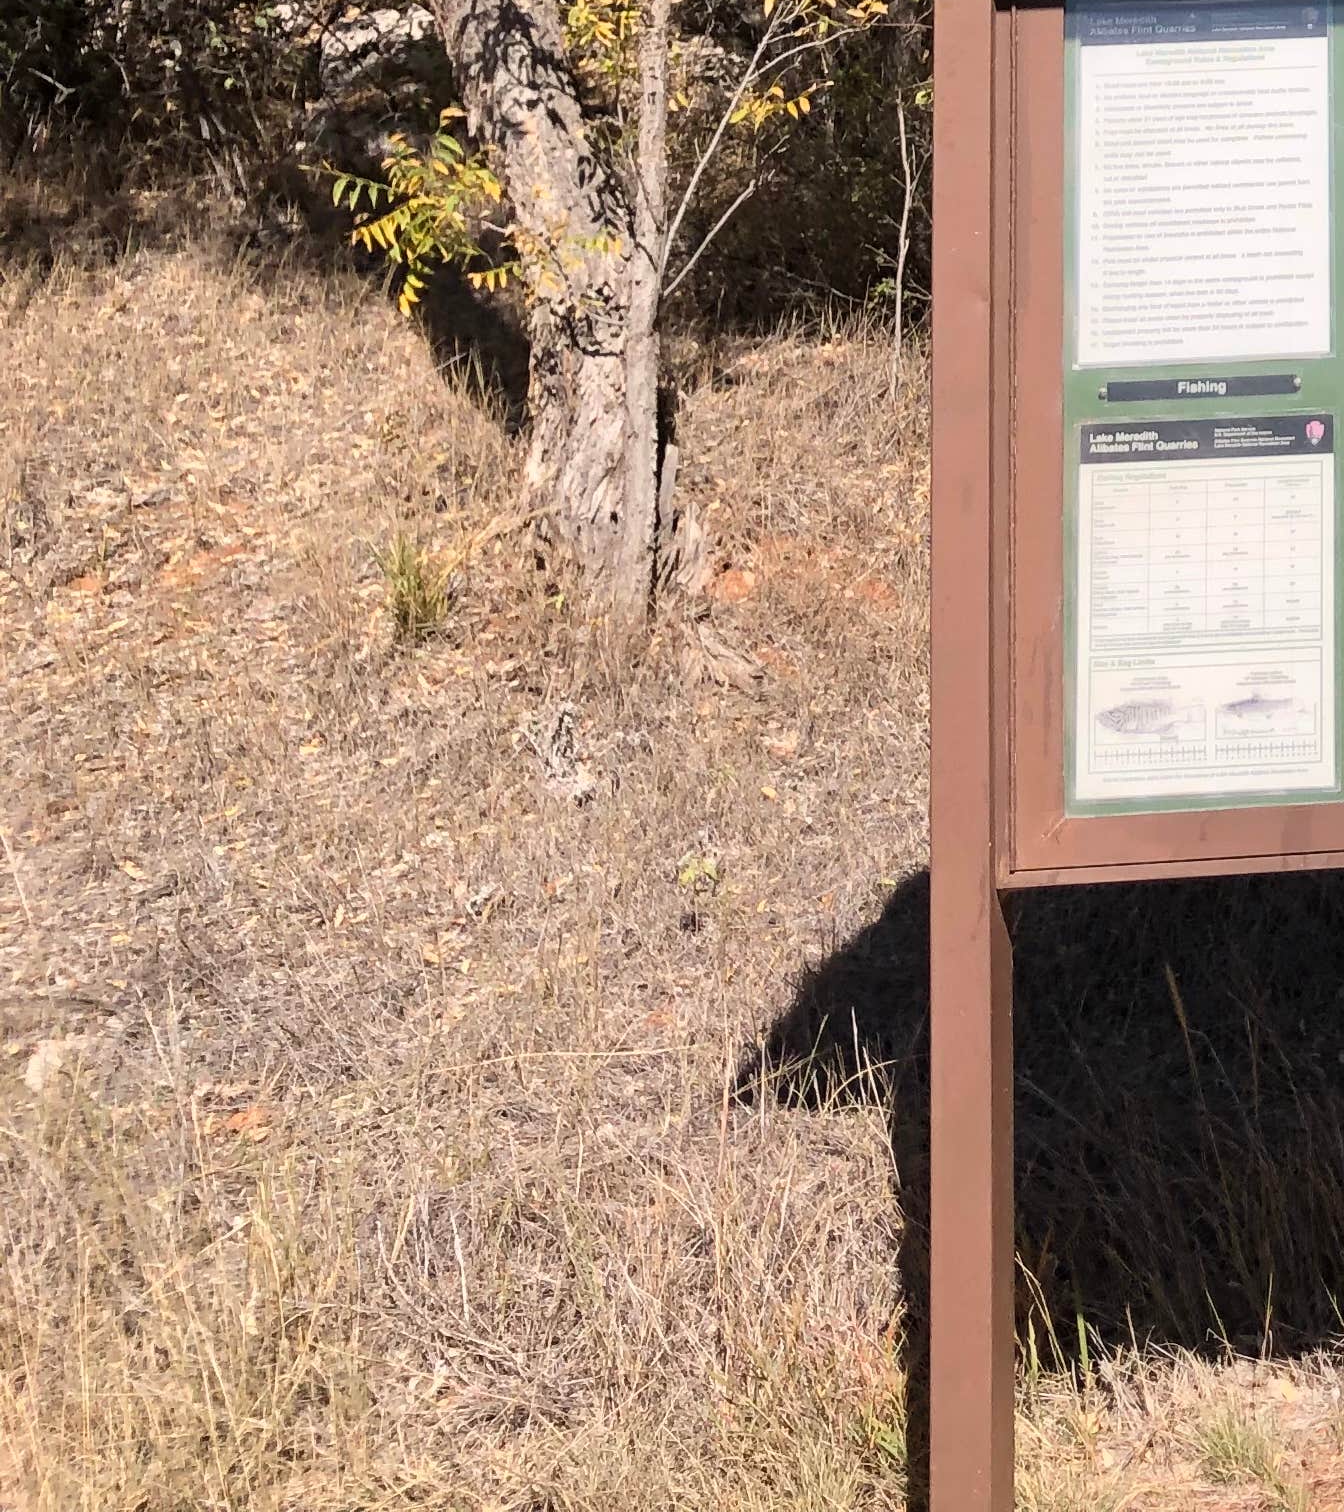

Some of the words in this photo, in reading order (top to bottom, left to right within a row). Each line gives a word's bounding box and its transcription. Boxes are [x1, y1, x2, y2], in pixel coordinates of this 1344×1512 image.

[1177, 380, 1227, 395] Fishing
[1089, 432, 1113, 443] Lake
[1115, 430, 1158, 441] Meredith
[1131, 441, 1154, 452] Flint
[1156, 440, 1198, 451] Quarries
